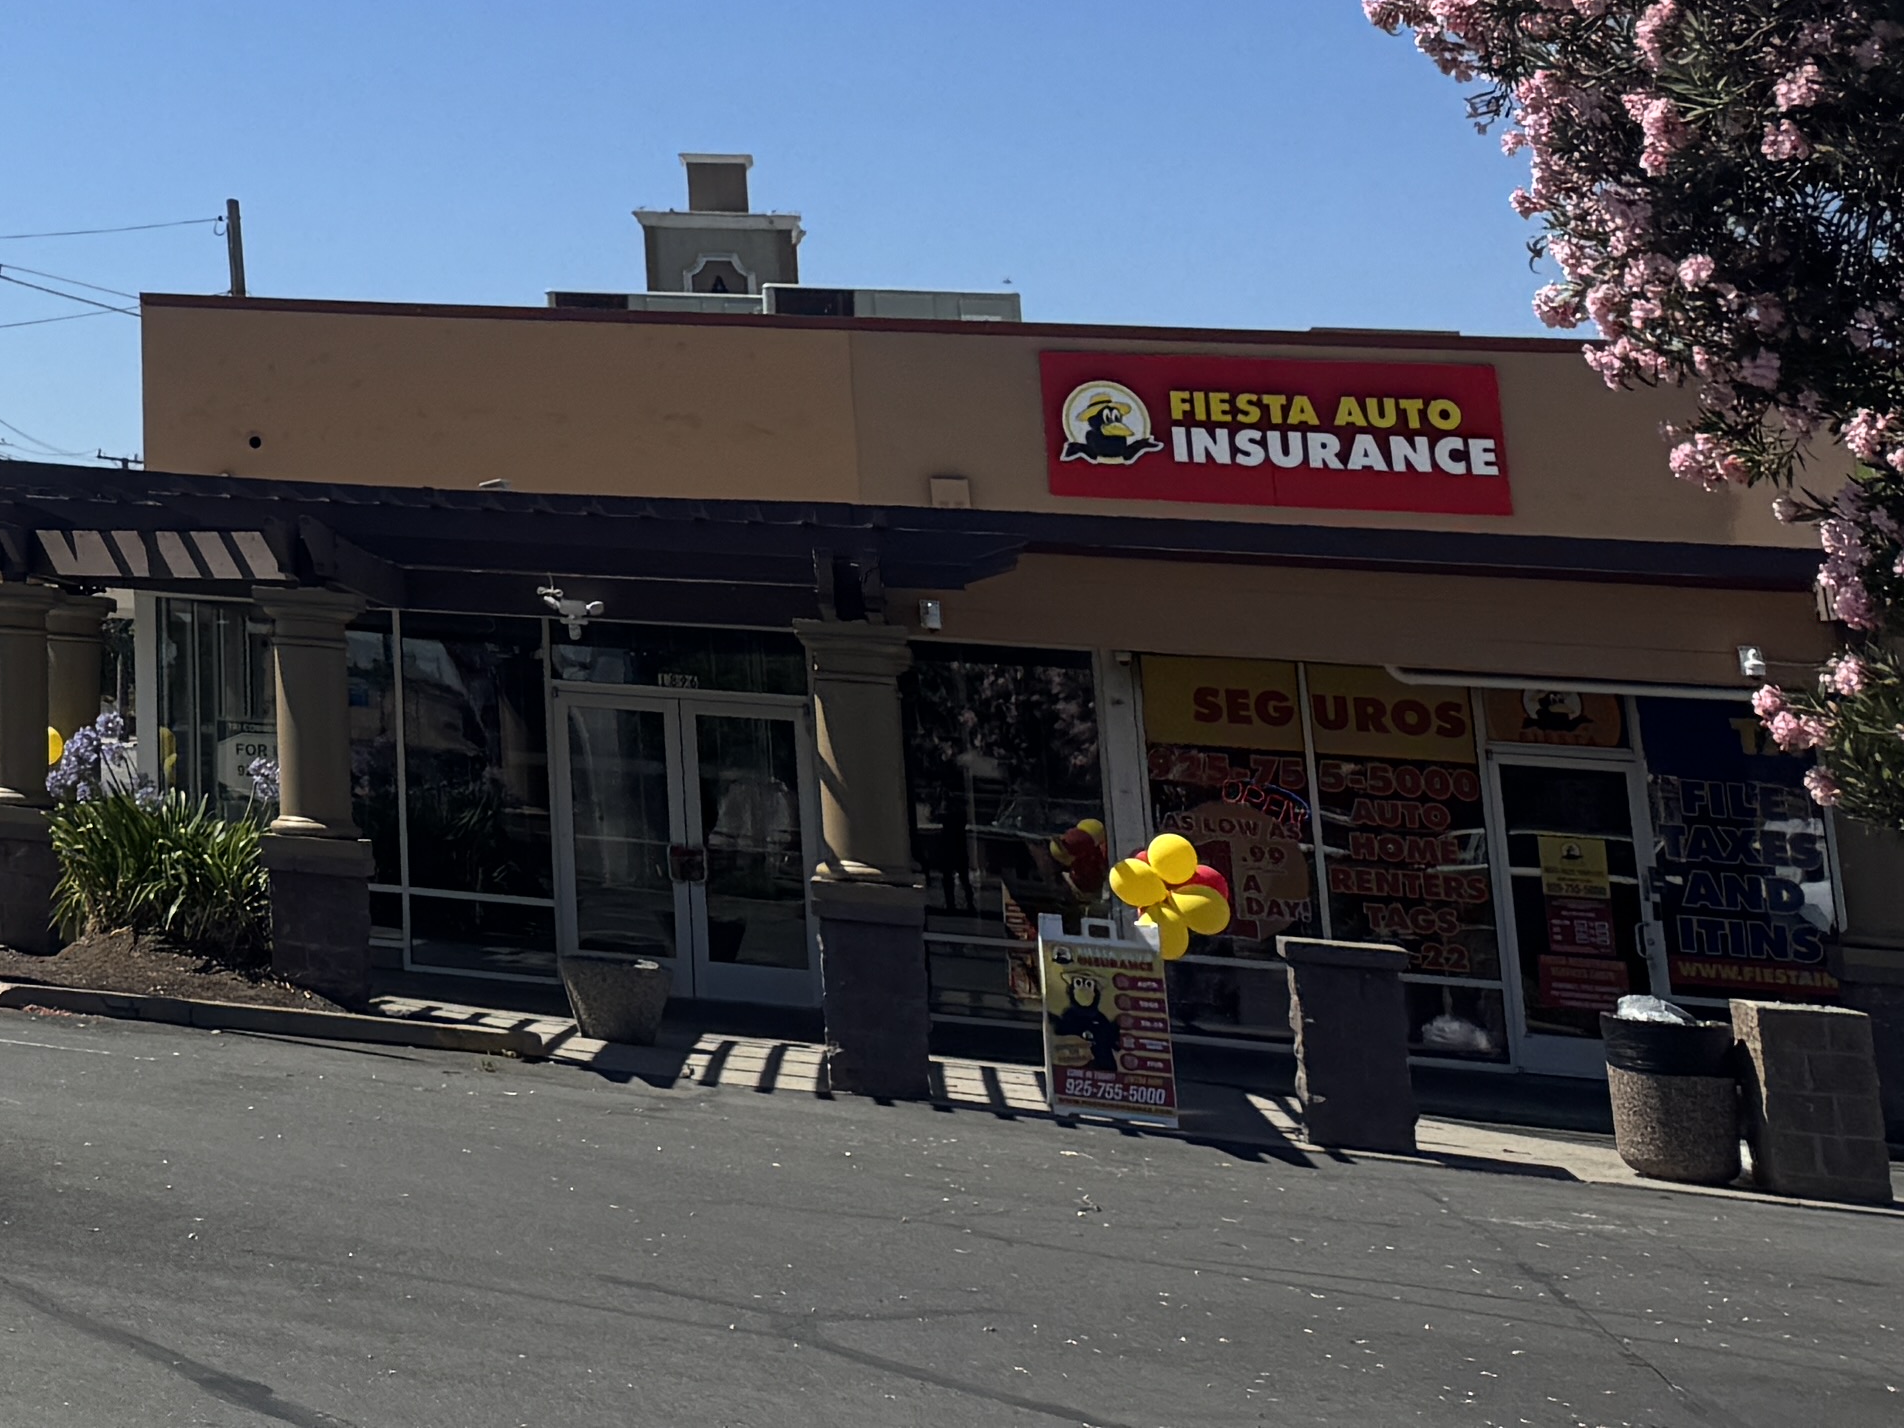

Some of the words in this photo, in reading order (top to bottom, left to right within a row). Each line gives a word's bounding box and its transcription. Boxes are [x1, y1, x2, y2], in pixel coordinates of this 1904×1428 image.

[1168, 389, 1320, 427] FIESTA
[1332, 395, 1463, 432] AUTO
[1170, 425, 1500, 477] INSURANCE
[235, 743, 268, 757] FOR
[1221, 779, 1308, 824] OPEN
[1350, 797, 1451, 832] AUTO
[1159, 812, 1194, 833] AS
[1201, 816, 1261, 837] LOW
[1268, 820, 1304, 840] AS
[1348, 831, 1462, 866] HOME
[1658, 822, 1825, 872] TAXES
[1242, 874, 1264, 894] A
[1329, 864, 1490, 904] RENTERS
[1681, 869, 1805, 915] AND
[1245, 896, 1312, 923] DAY!
[1363, 901, 1460, 937] TAGS
[1676, 914, 1825, 965] ITINS
[1065, 1078, 1166, 1105] 925-755-5000
